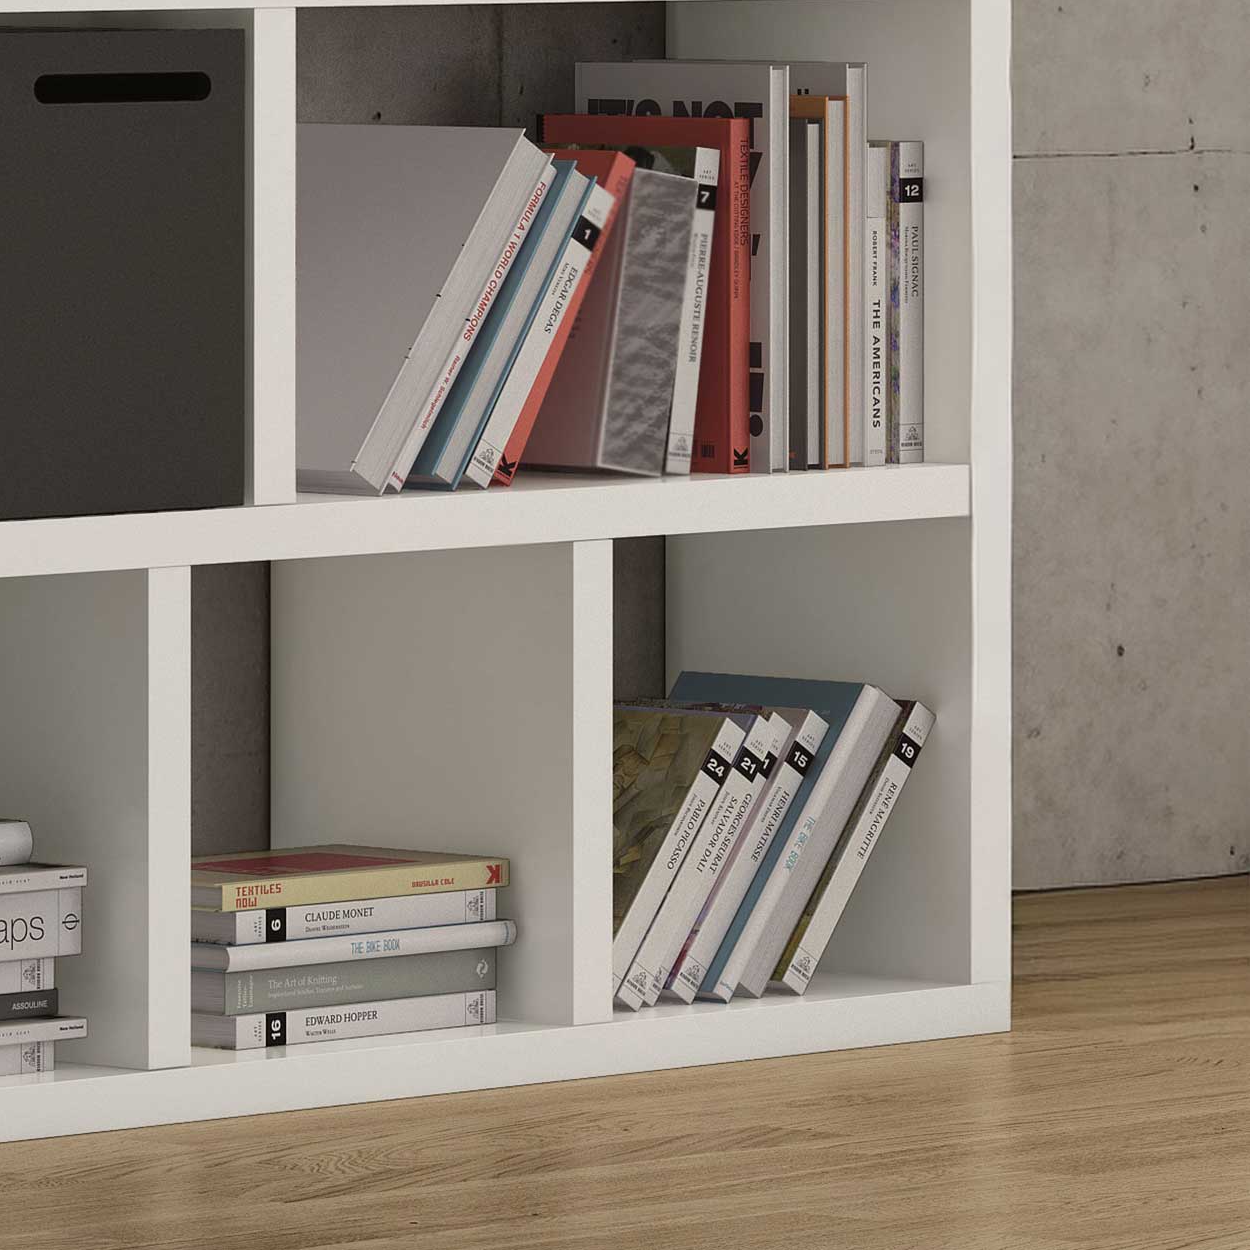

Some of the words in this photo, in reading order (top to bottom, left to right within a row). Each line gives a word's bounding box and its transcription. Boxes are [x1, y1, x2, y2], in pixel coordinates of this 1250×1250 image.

[740, 139, 749, 179] TEXTILE
[700, 191, 710, 204] 7
[904, 184, 920, 197] 12
[740, 183, 749, 246] DESIGNERS
[911, 226, 919, 255] PAUL
[559, 265, 578, 299] EDGAR
[911, 256, 919, 298] SIGNAC
[543, 300, 563, 335] DEGAS
[793, 750, 808, 768] 15
[900, 741, 915, 759] 19
[740, 756, 757, 775] 21
[772, 790, 790, 820] HENRI
[751, 820, 775, 863] MATISSE
[304, 909, 341, 922] CLAUDE
[343, 906, 374, 920] MONET
[350, 941, 364, 955] THE
[365, 940, 382, 954] BIKE
[382, 938, 400, 953] BOOK
[268, 979, 283, 990] The
[284, 978, 297, 989] Art
[298, 976, 307, 988] of
[308, 974, 338, 988] Knitting
[11, 1000, 48, 1011] ASSOULINE
[305, 1013, 342, 1027] EDWARD
[343, 1010, 378, 1024] HOPPER
[270, 1019, 282, 1041] 16
